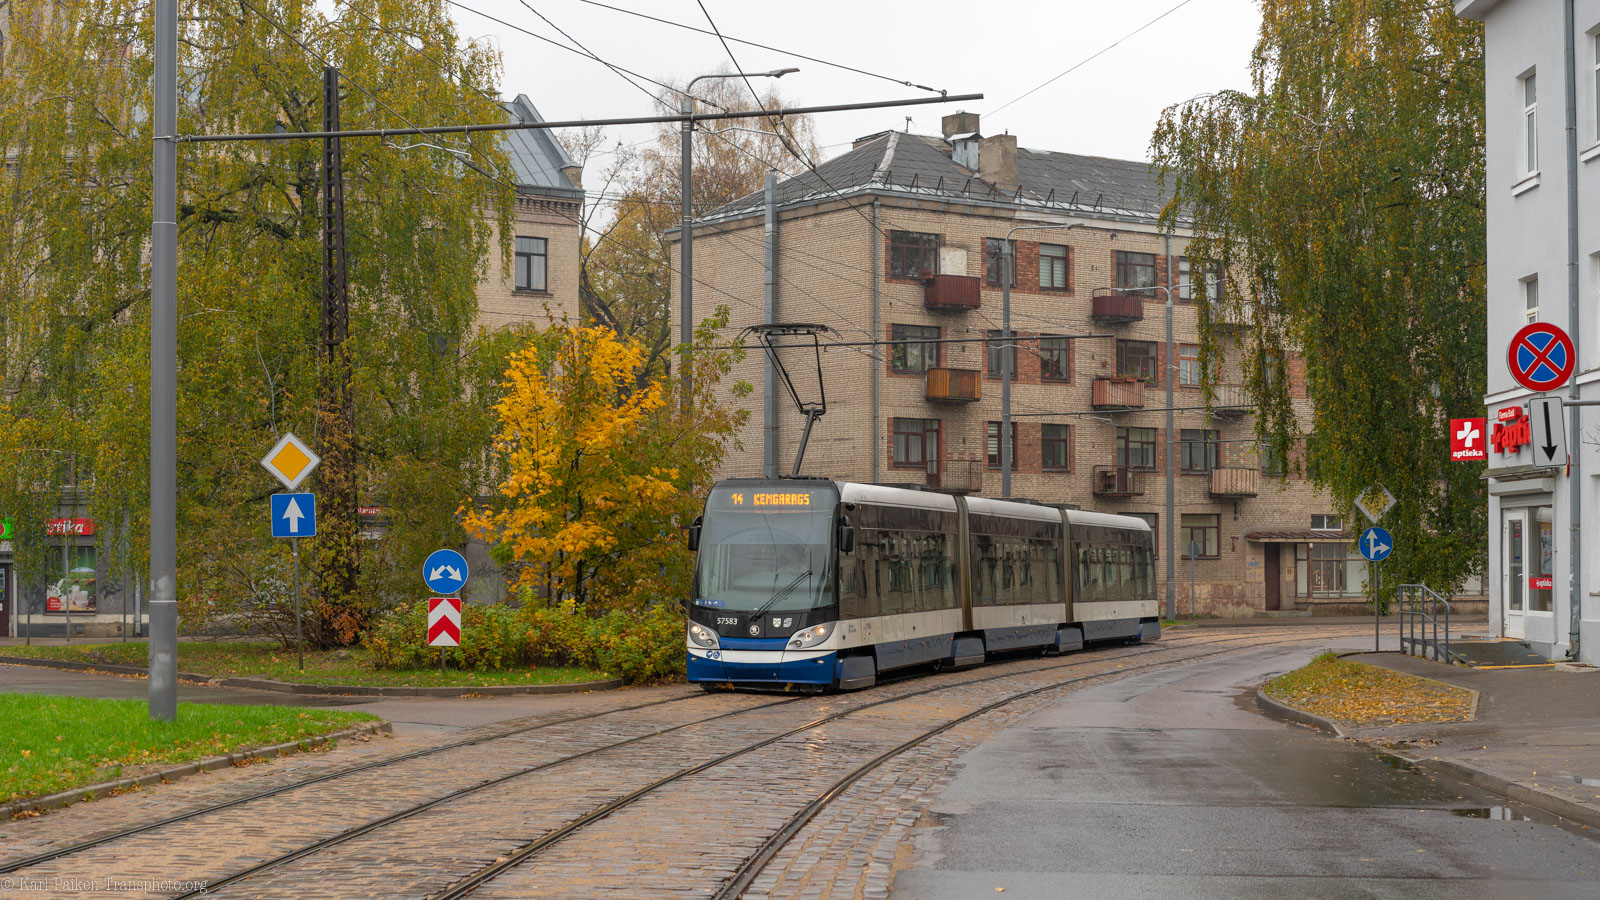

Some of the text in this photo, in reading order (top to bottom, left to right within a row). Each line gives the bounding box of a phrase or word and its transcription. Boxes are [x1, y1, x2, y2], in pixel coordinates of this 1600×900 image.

[1453, 449, 1483, 458] aptieka
[731, 493, 743, 505] 14
[716, 617, 738, 625] 57583
